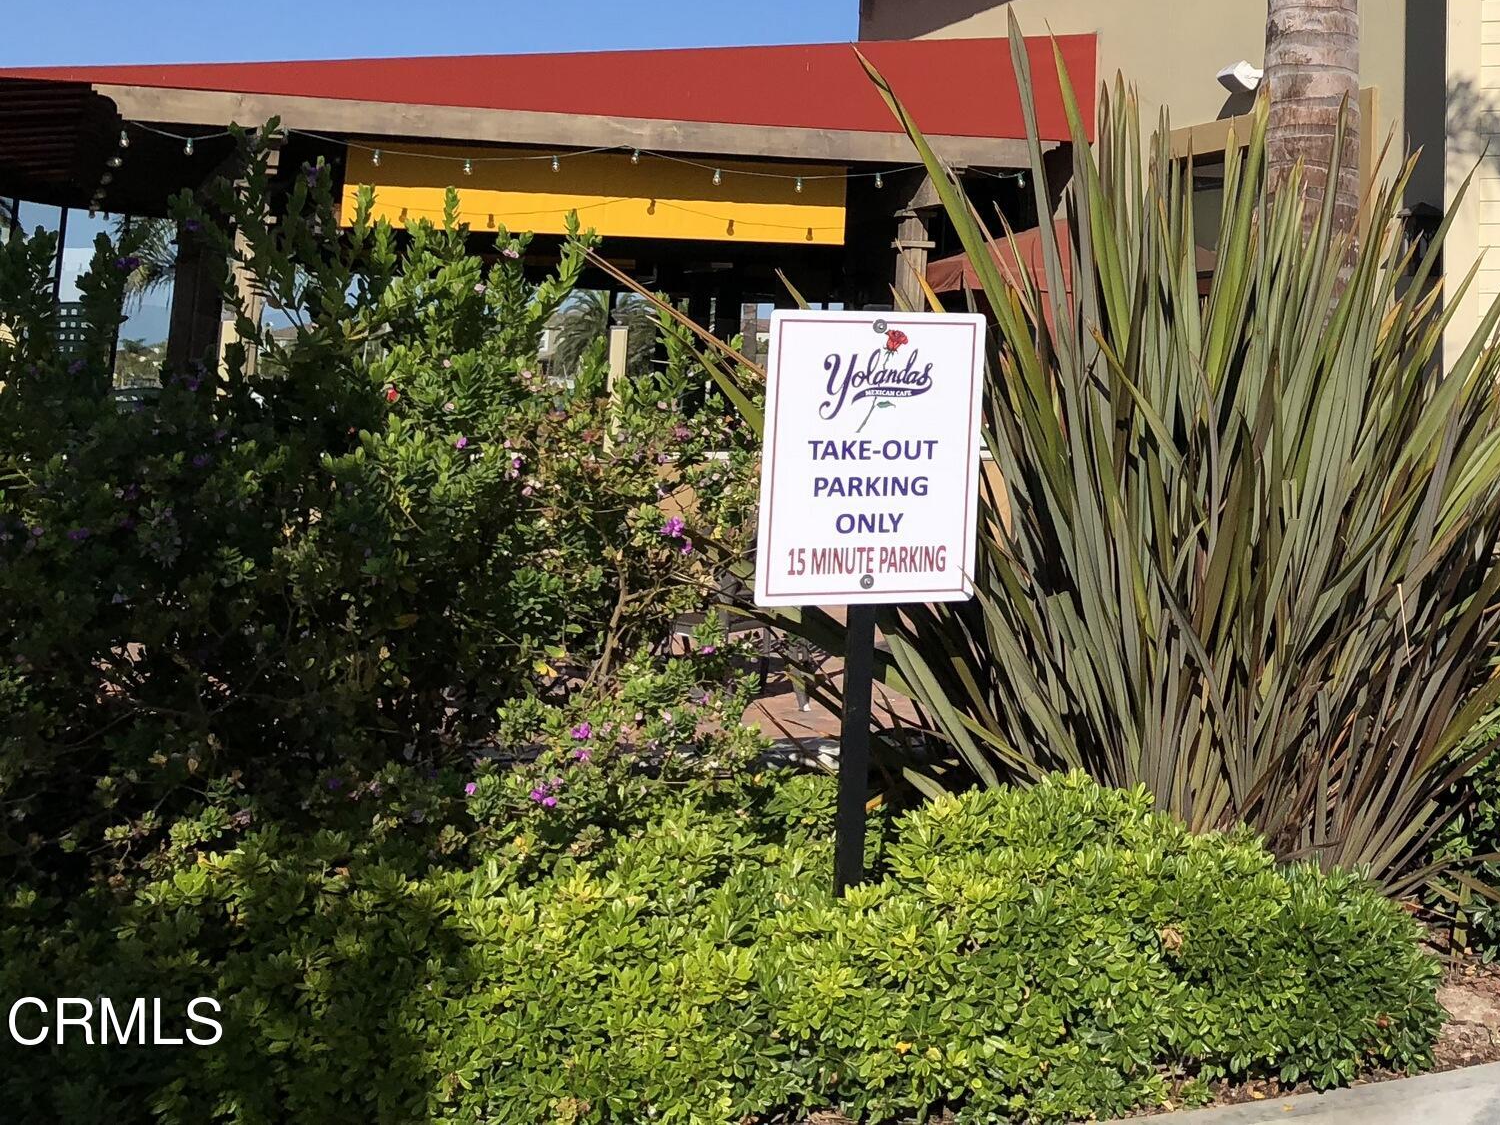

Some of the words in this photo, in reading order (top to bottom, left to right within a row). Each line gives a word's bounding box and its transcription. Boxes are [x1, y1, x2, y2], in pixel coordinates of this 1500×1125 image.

[818, 348, 933, 420] Yolandas
[807, 439, 939, 461] TAKE-OUT
[813, 475, 929, 498] PARKING
[835, 512, 904, 535] ONLY
[787, 547, 806, 576] 15
[811, 546, 875, 575] MINUTE
[878, 545, 947, 574] PARKING
